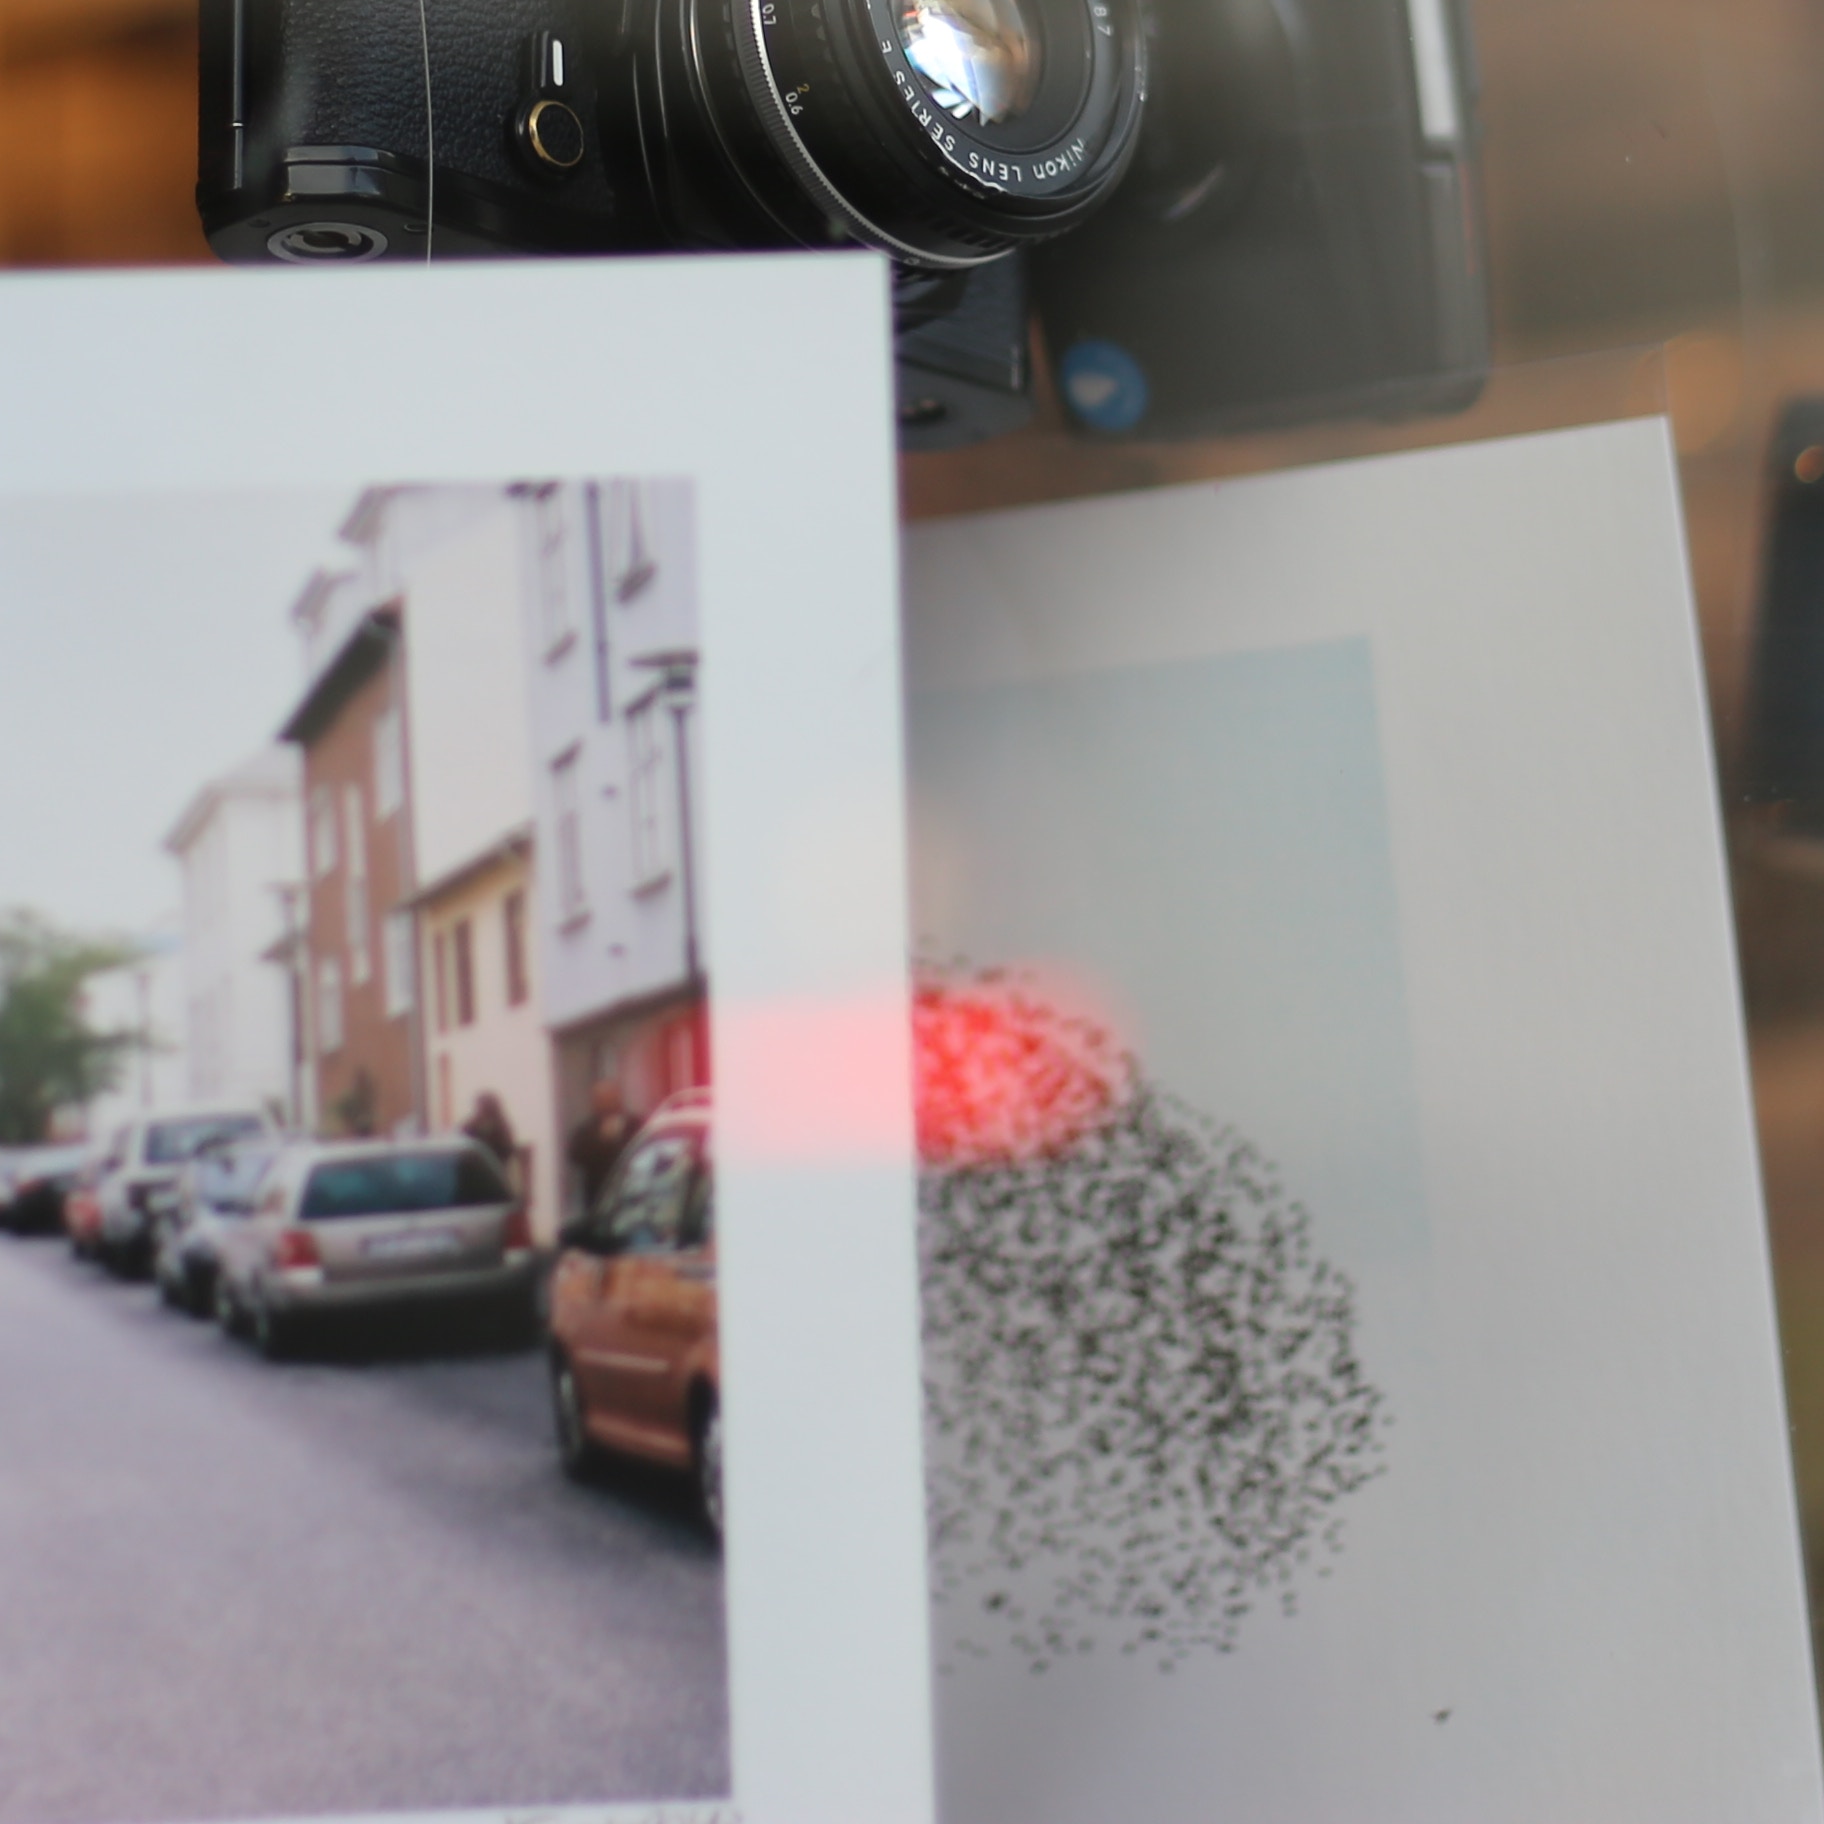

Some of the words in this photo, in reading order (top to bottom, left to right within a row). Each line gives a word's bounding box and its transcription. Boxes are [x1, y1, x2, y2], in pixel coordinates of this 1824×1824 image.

[762, 3, 777, 25] 0.7
[881, 39, 892, 54] E
[785, 91, 803, 116] 0.6
[894, 70, 956, 152] SERIES
[968, 152, 1022, 182] LENS
[1032, 138, 1086, 180] Nikon
